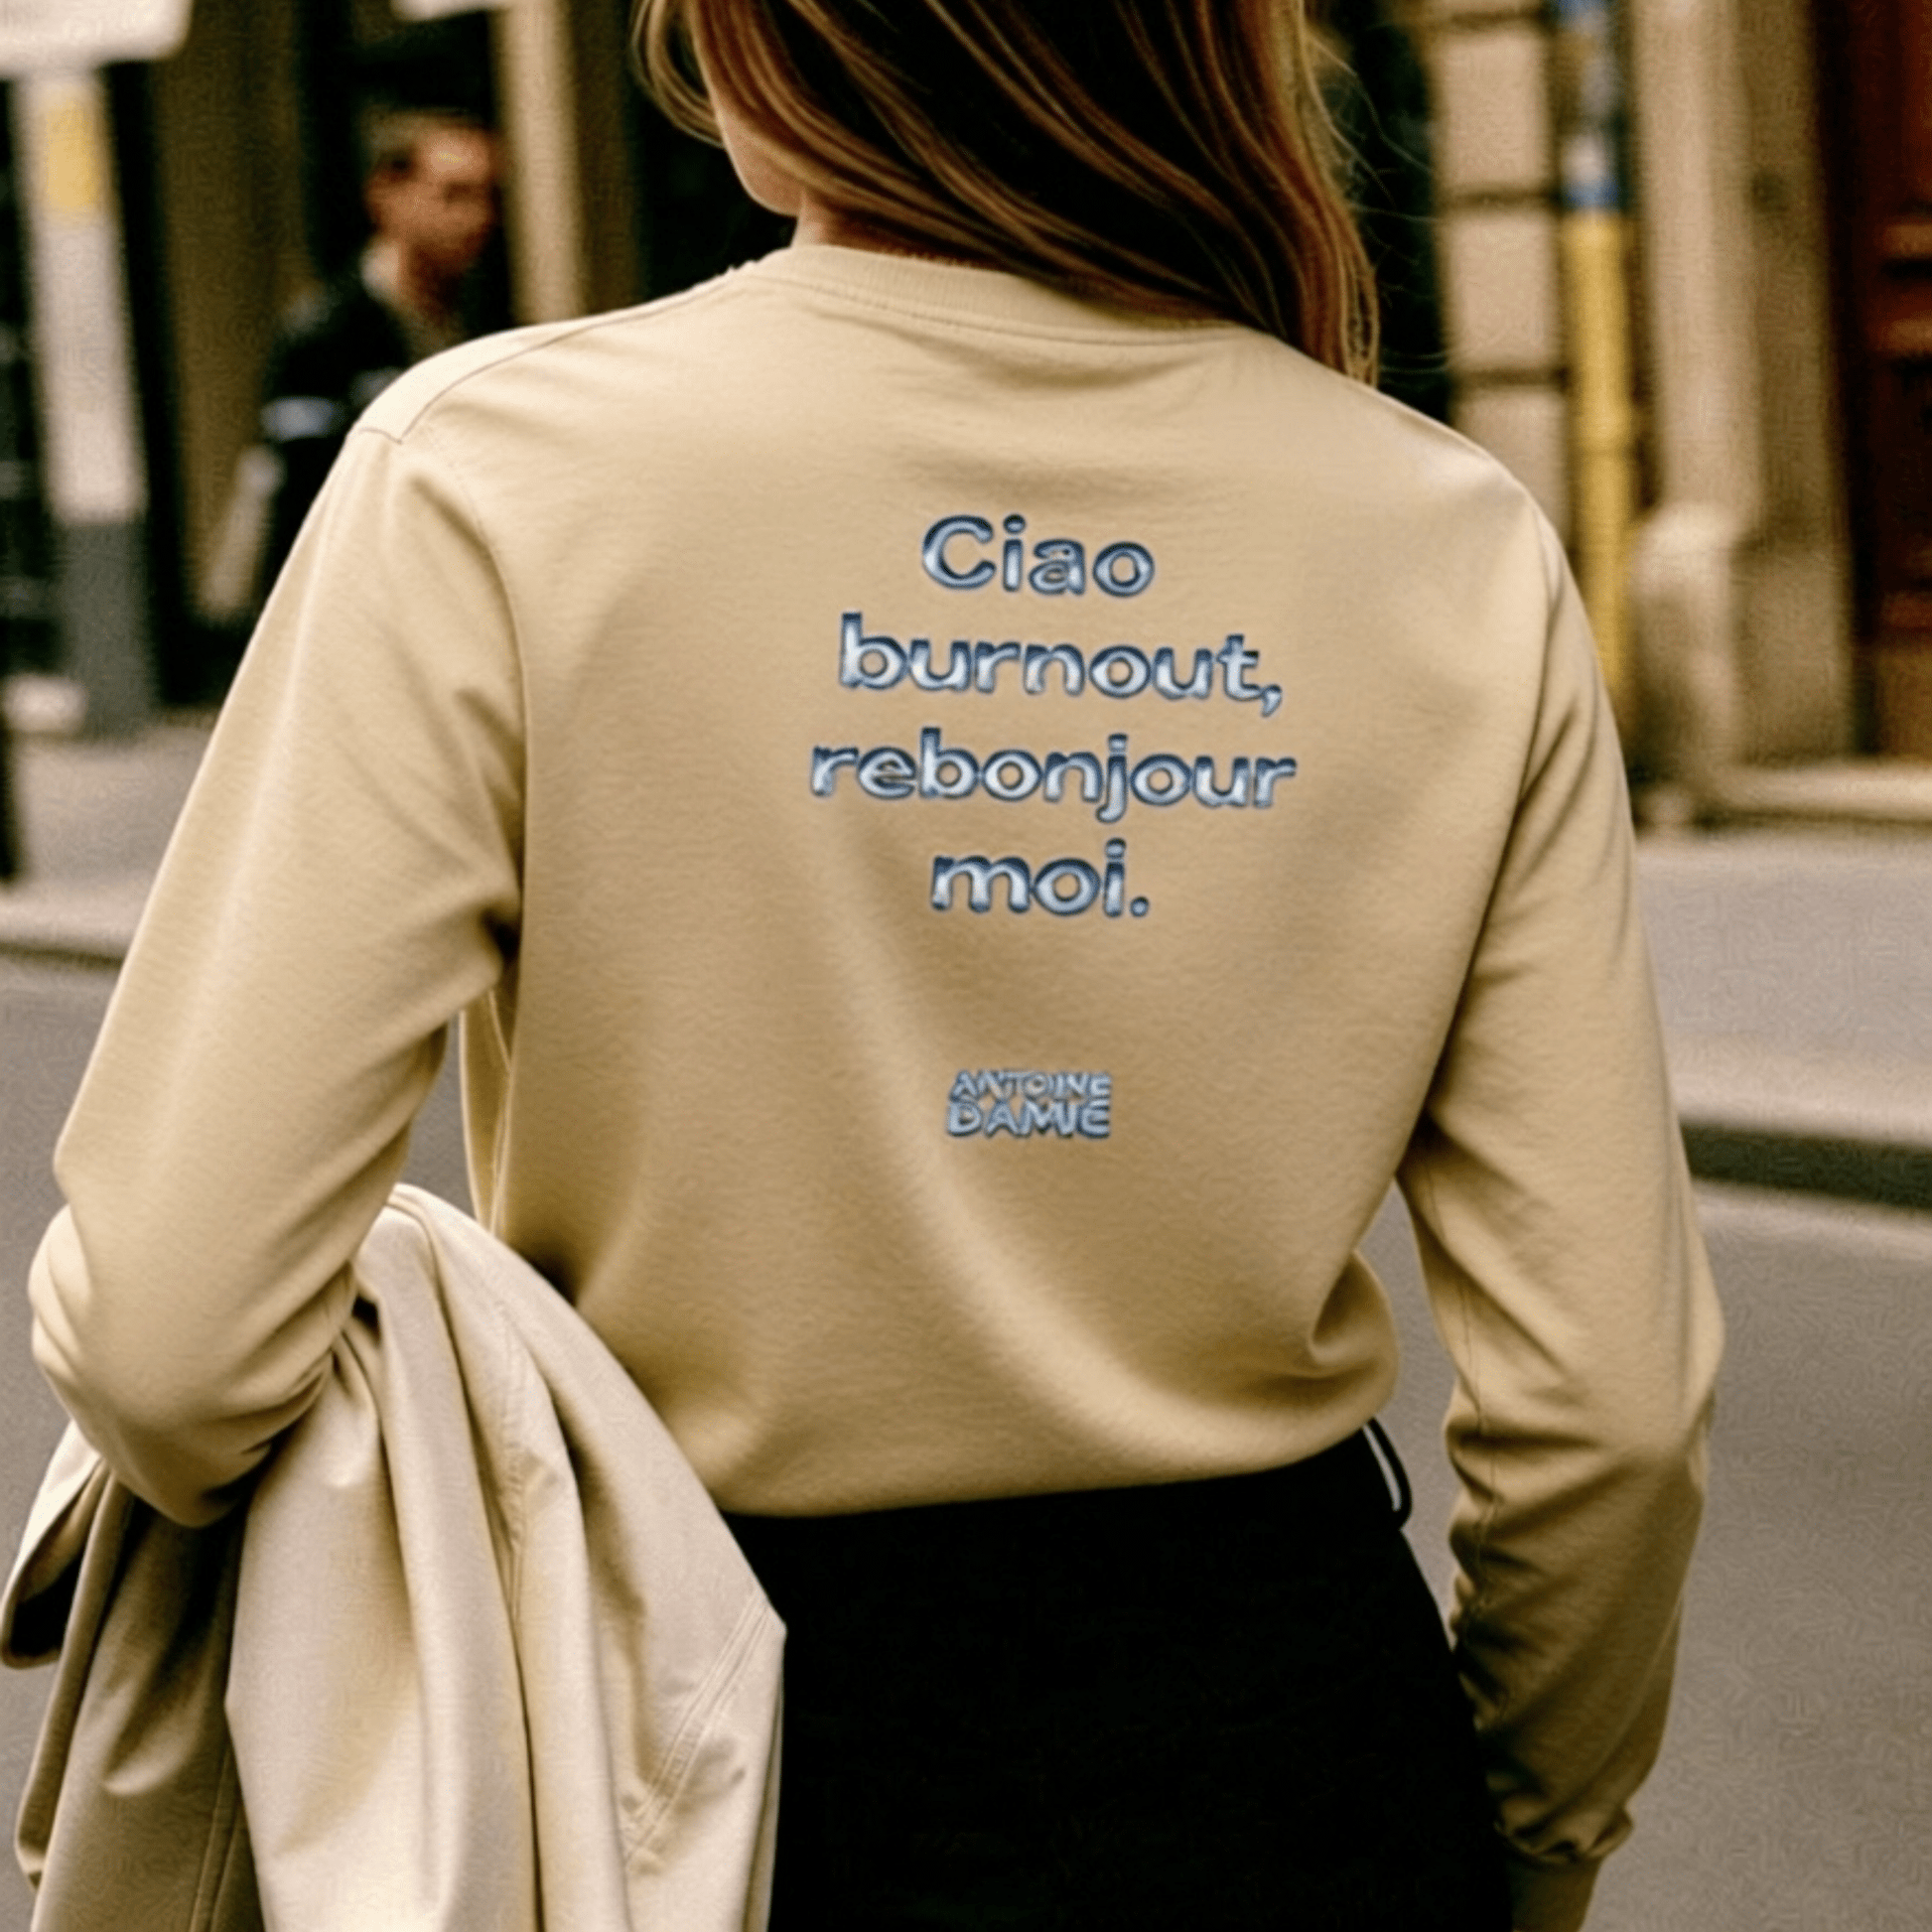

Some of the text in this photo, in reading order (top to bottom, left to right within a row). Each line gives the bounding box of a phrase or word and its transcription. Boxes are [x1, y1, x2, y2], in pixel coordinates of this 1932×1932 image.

[922, 513, 1156, 597] Ciao
[840, 612, 1283, 717] burnout,
[810, 727, 1297, 824] rebonjour
[930, 837, 1150, 917] moi.
[950, 1069, 1112, 1099] ANTOINE
